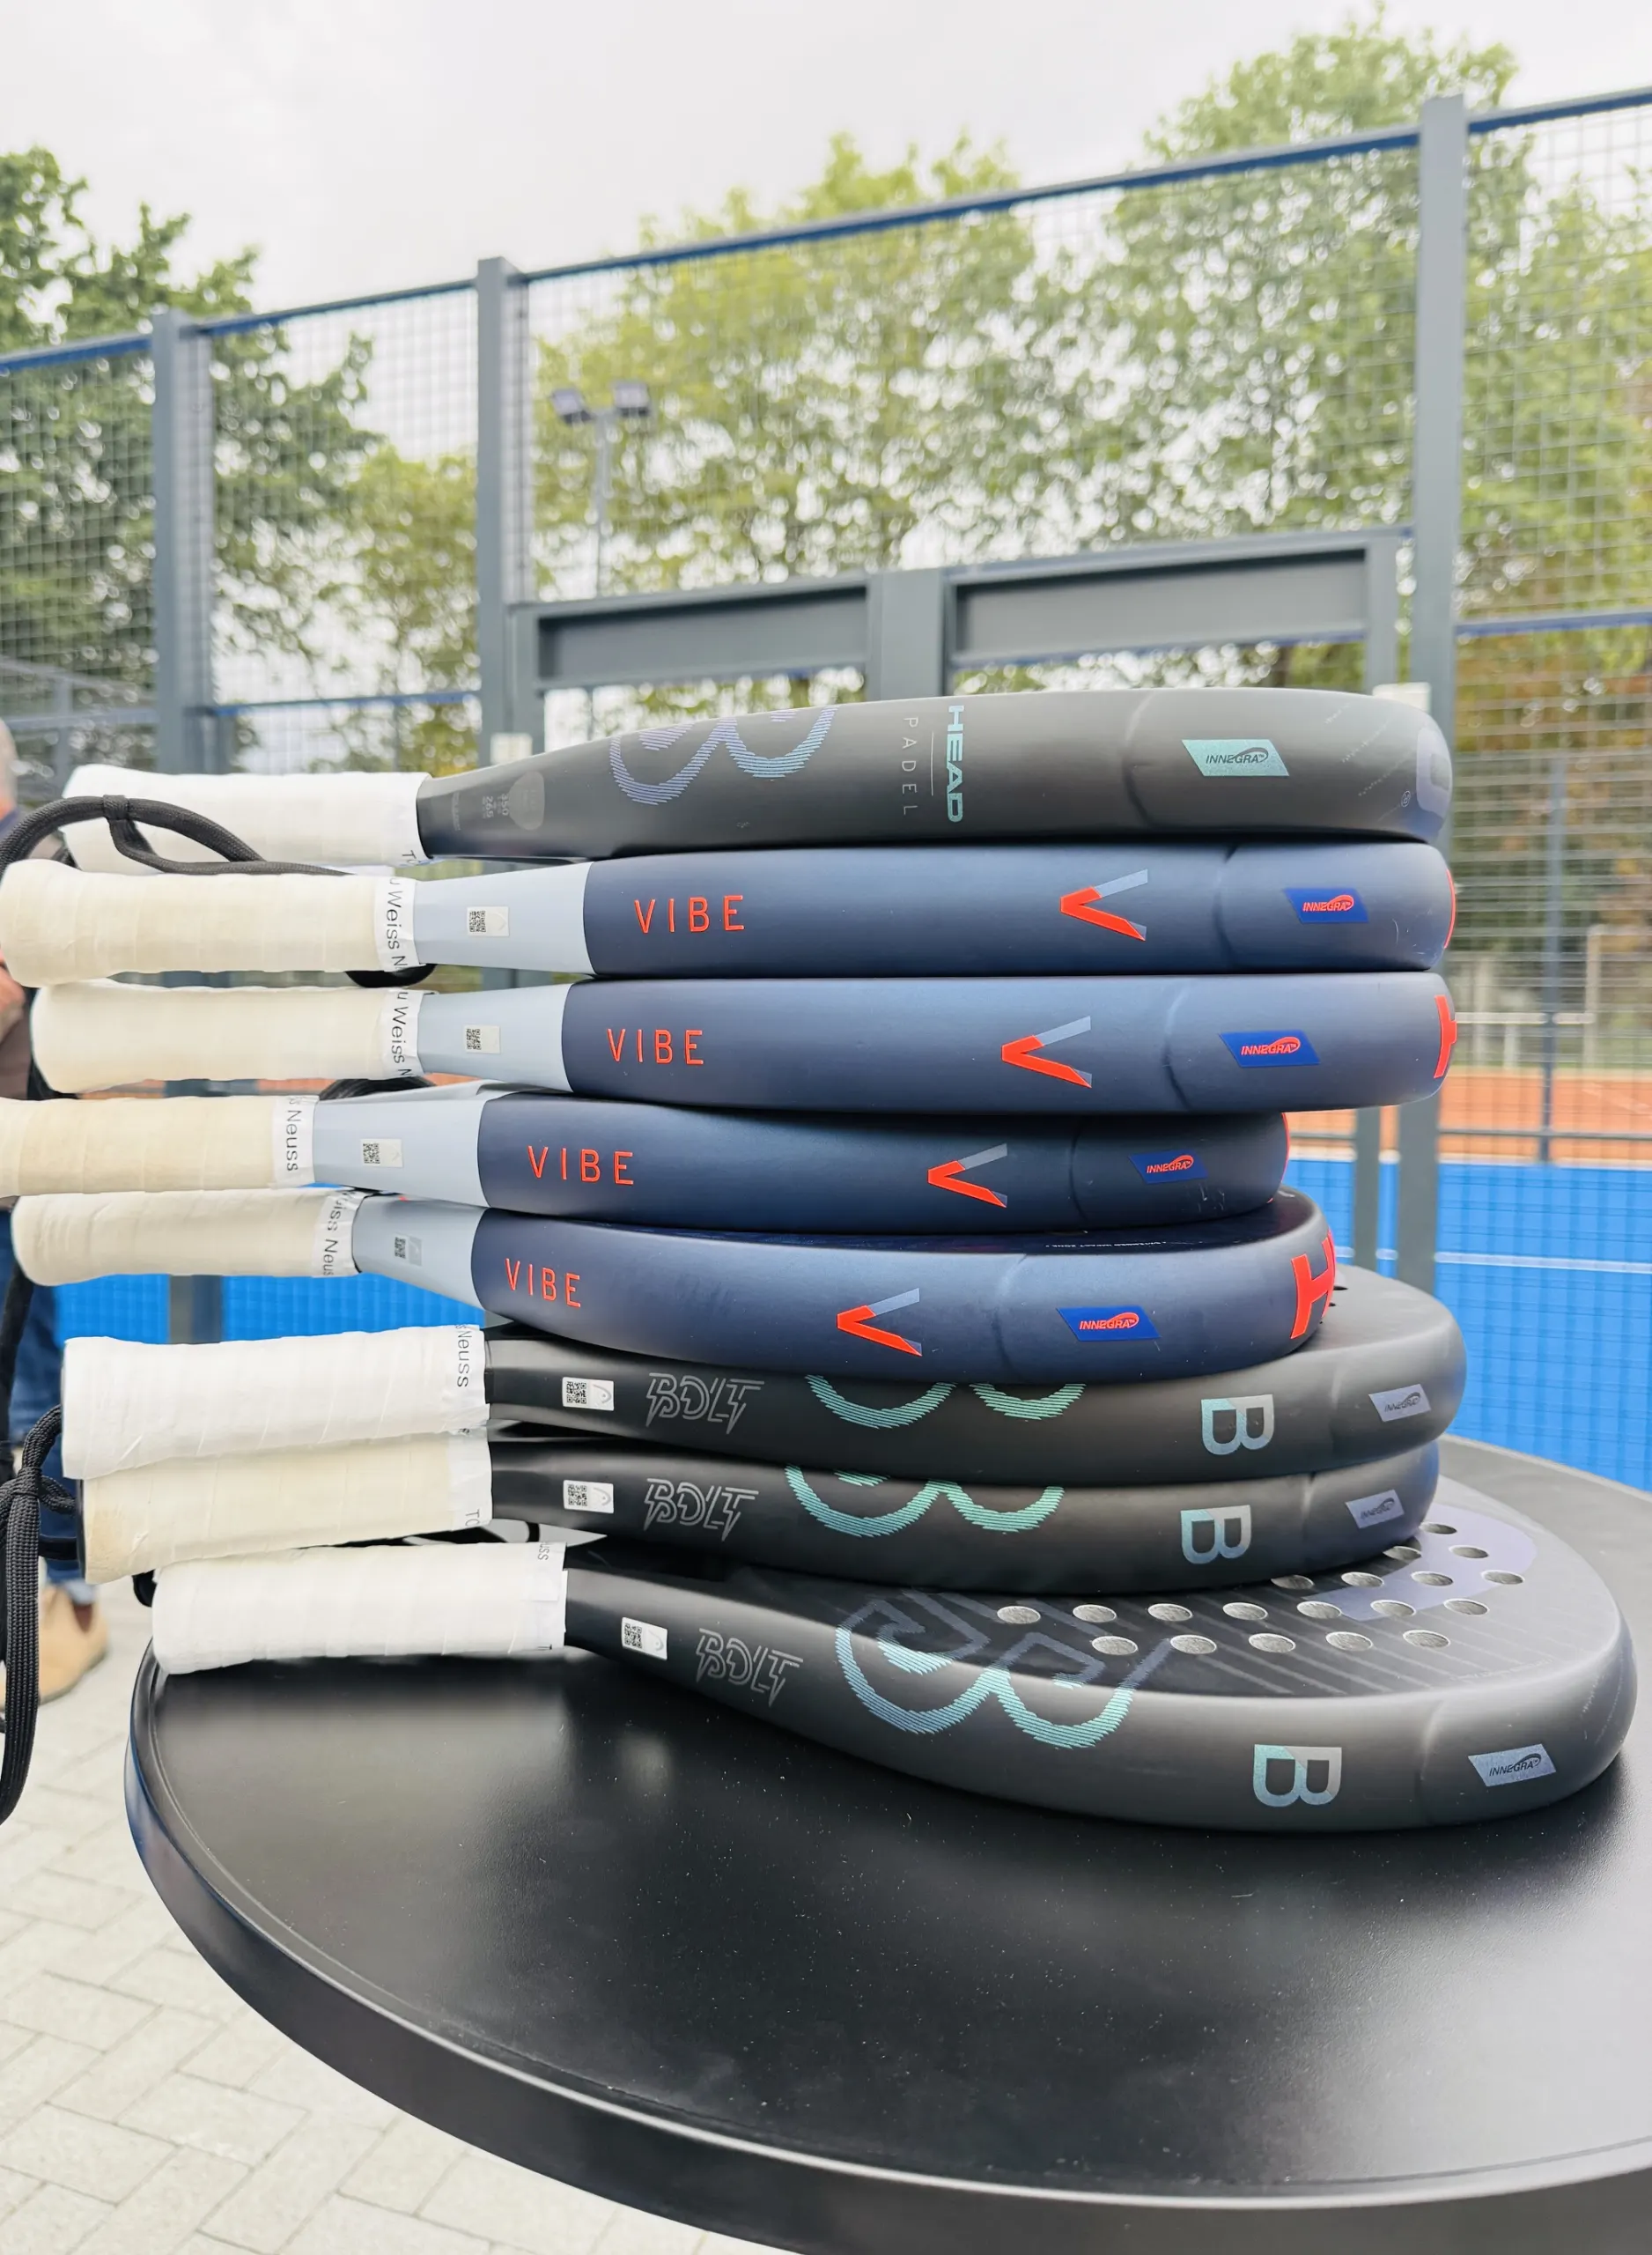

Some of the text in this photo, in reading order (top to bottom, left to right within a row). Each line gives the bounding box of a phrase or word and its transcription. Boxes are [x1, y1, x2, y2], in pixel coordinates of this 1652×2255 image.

[902, 717, 918, 816] PADEL
[947, 705, 965, 823] HEAD
[387, 891, 403, 950] Weiss
[634, 895, 744, 934] VIBE
[391, 1006, 409, 1064] Weiss
[607, 1028, 704, 1066] VIBE
[285, 1110, 302, 1172] Neuss
[527, 1145, 634, 1185] VIBE
[505, 1258, 581, 1308] VIBE
[457, 1331, 472, 1387] Neuss
[645, 1372, 765, 1435] BOLT
[644, 1478, 759, 1542] BOLT
[696, 1629, 803, 1707] BOLT
